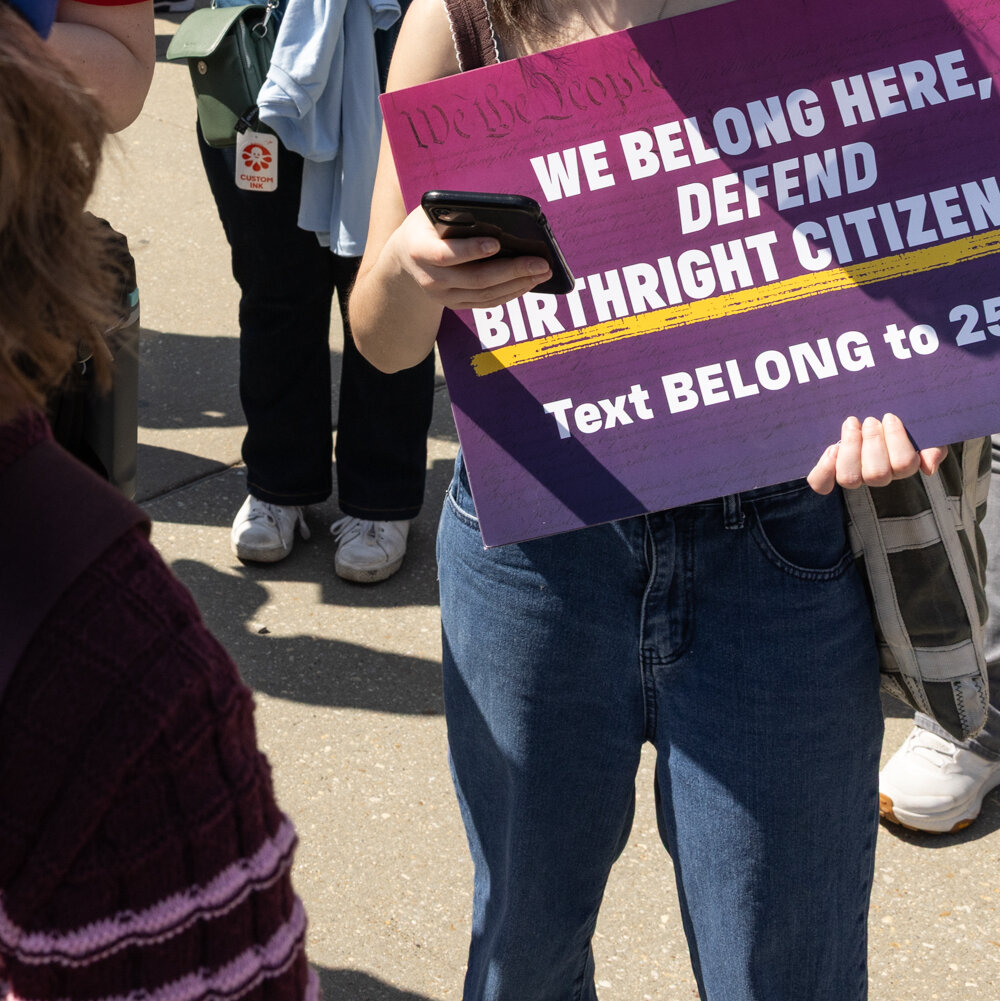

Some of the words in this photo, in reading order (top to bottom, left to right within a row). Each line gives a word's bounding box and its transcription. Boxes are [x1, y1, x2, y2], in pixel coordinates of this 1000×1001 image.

[240, 174, 274, 183] CUSTOM
[529, 139, 616, 203] WE
[619, 88, 825, 181] BELONG
[831, 49, 993, 128] HERE,
[249, 182, 264, 190] INK
[676, 141, 878, 235] DEFEND
[472, 230, 779, 351] BIRTHRIGHT
[792, 176, 1000, 272] CITIZEN
[542, 384, 655, 440] Text
[661, 330, 876, 415] BELONG
[882, 323, 940, 360] to
